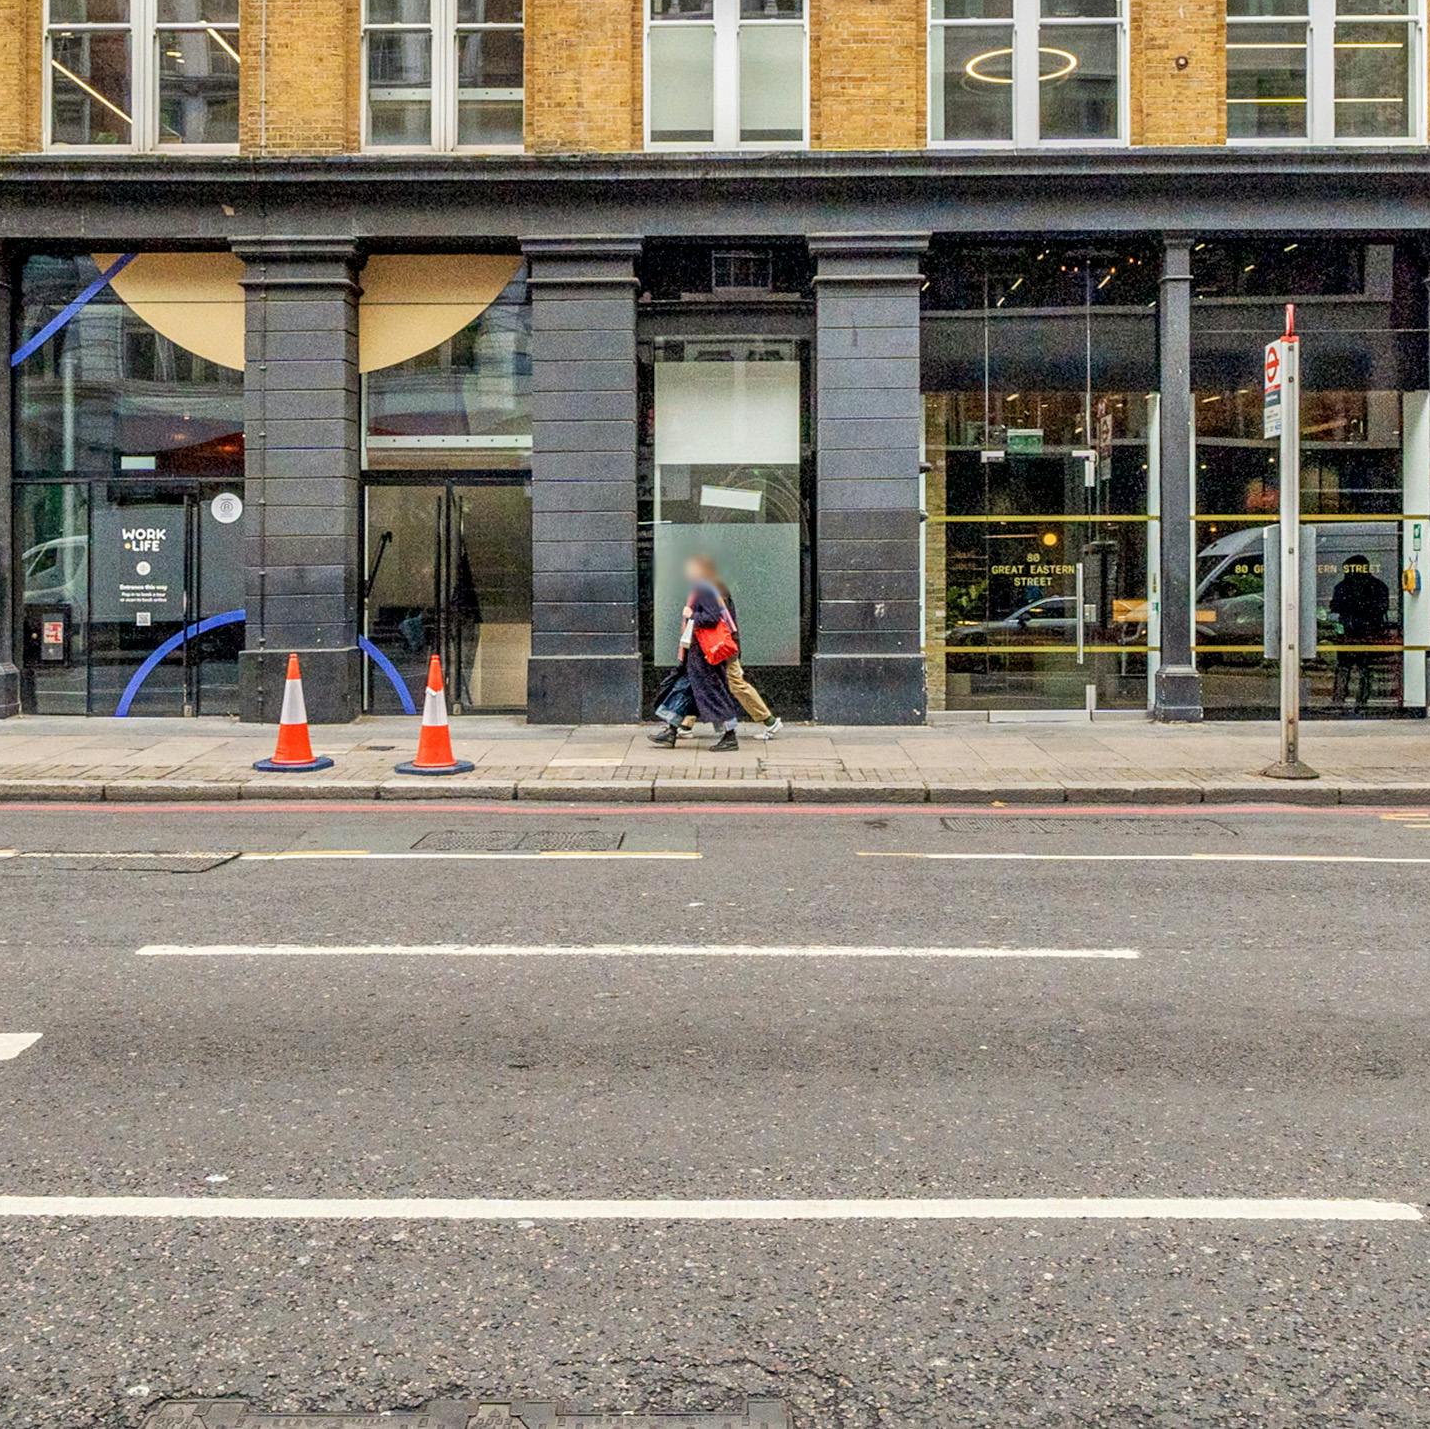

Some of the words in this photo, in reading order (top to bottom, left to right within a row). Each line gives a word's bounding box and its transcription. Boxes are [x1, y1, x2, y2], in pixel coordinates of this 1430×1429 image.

[122, 528, 166, 540] WORK
[1027, 553, 1040, 562] 80
[991, 565, 1024, 574] GREAT
[1031, 565, 1075, 574] EASTERN
[1235, 564, 1248, 574] 80
[1343, 564, 1381, 573] STREET
[1014, 577, 1052, 586] STREET
